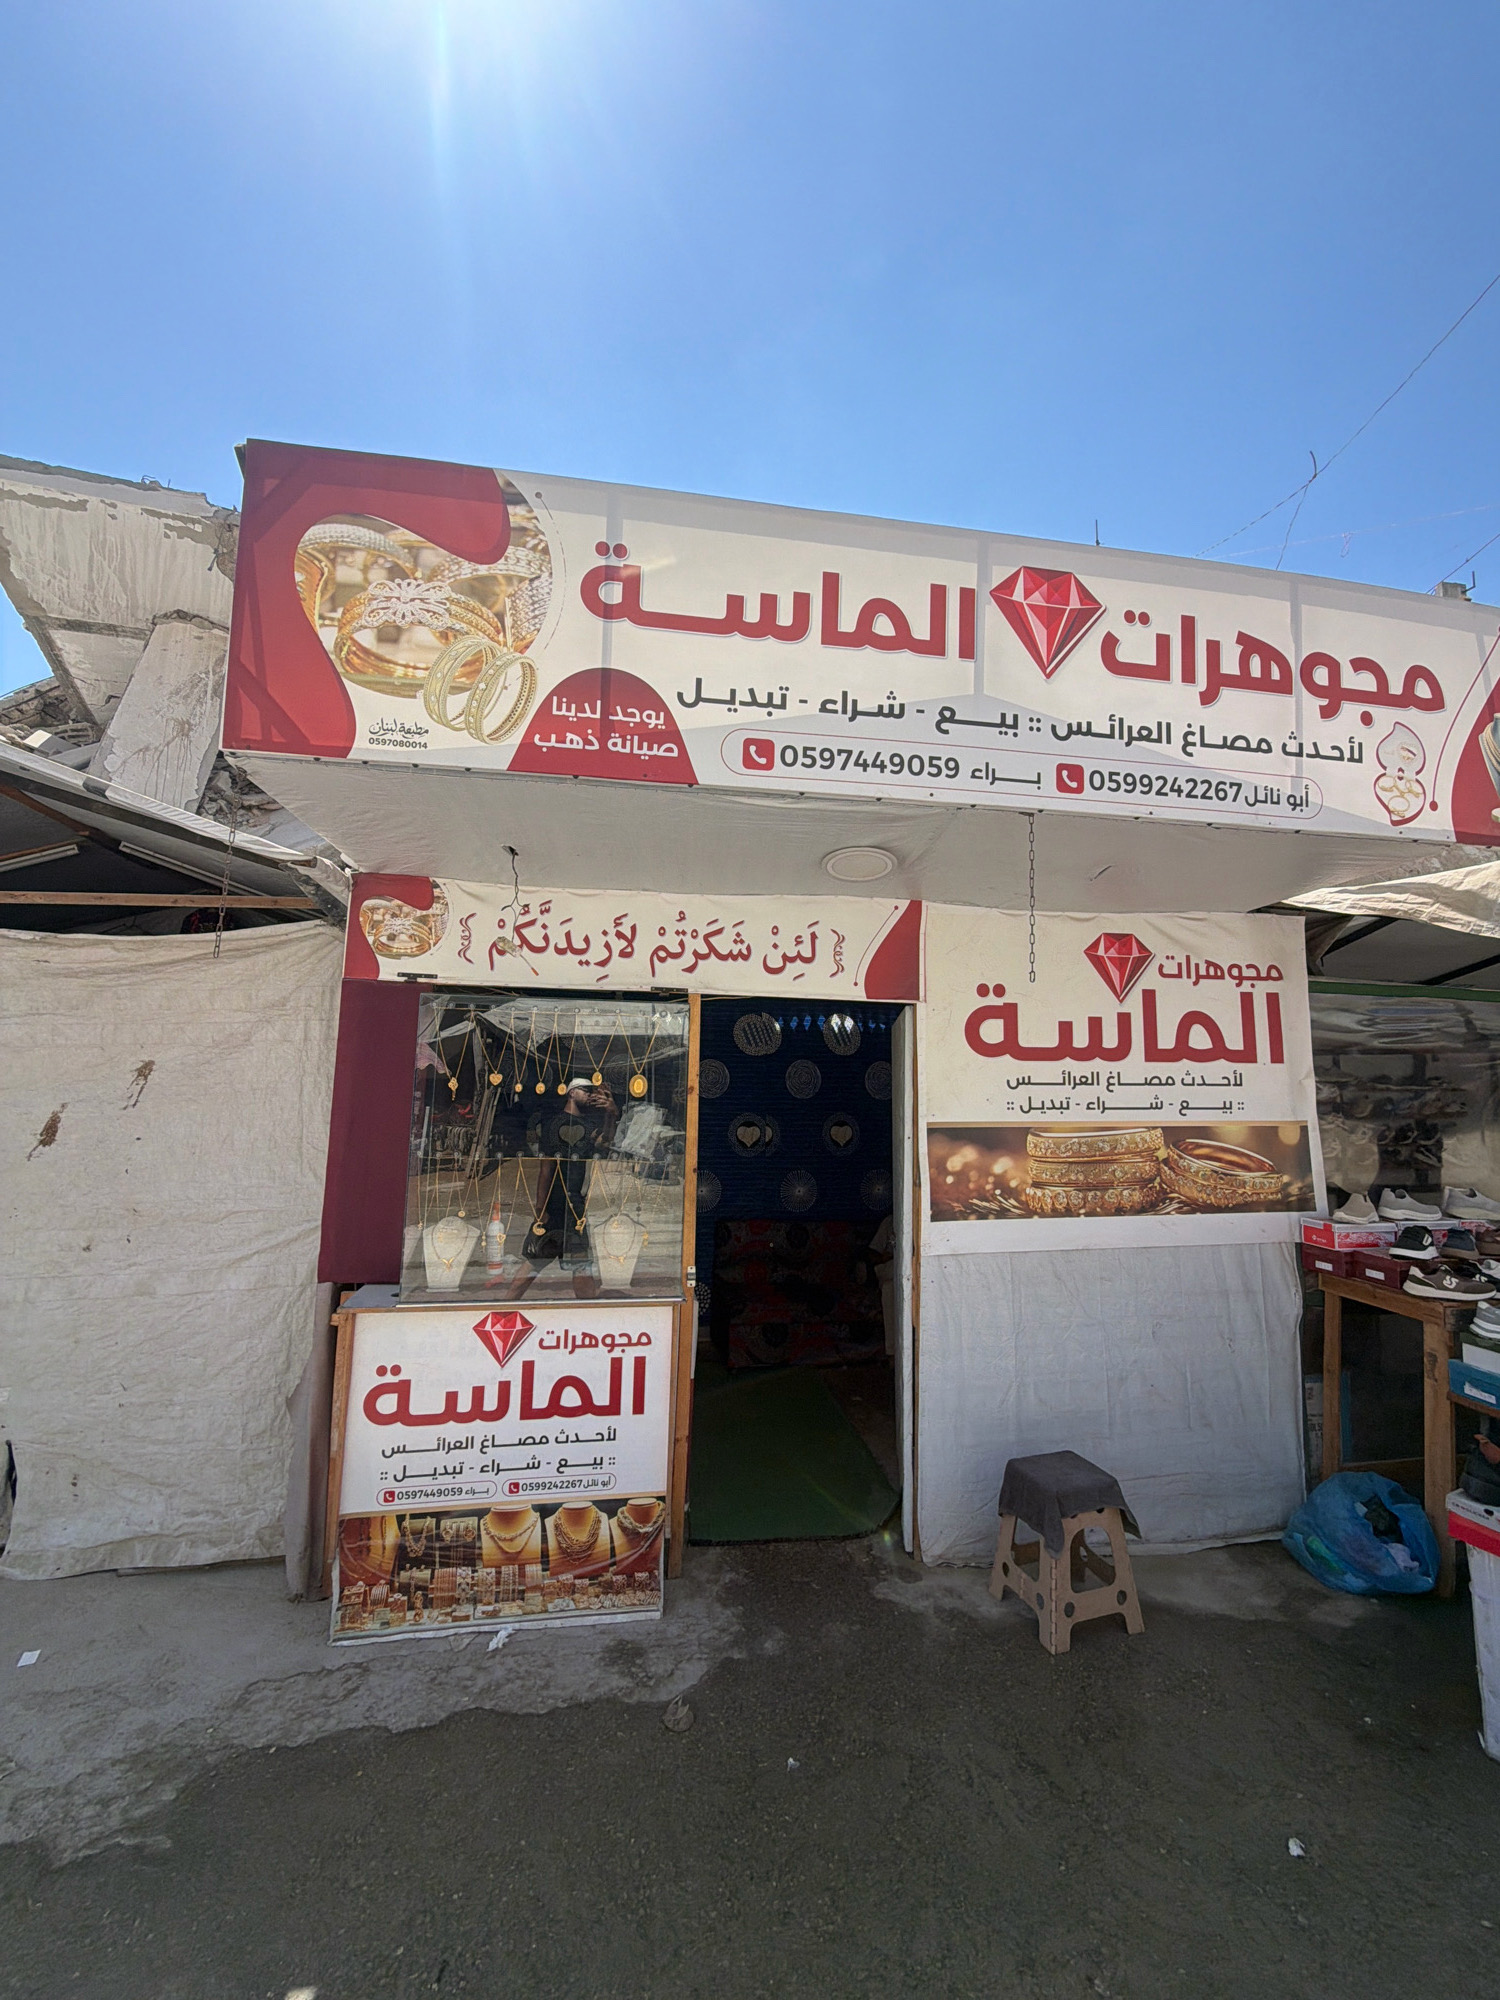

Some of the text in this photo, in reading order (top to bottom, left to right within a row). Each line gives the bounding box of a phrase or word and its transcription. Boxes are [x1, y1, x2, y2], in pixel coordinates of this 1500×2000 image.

[580, 541, 1445, 727] مجوهرات الماسة
[553, 696, 665, 729] يوجد لدينا
[677, 678, 789, 717] تبديل
[819, 691, 905, 722] شراء
[935, 706, 1018, 737] بيع
[1051, 714, 1171, 747] العرائس
[369, 738, 427, 749] 0597080014
[534, 729, 678, 759] صيانة ذهب
[1182, 723, 1272, 757] مصاغ
[1282, 731, 1363, 763] لأحدث
[779, 744, 1309, 812] أبو نائل 0599242267 براء 0597449059
[1158, 955, 1283, 988] مجوهرات
[965, 983, 1284, 1064] الماسة
[1007, 1070, 1242, 1092] لأحدث مصاغ العرائس
[1020, 1096, 1070, 1114] تبديل
[1086, 1095, 1163, 1114] شراء
[1179, 1100, 1232, 1116] بيع
[539, 1329, 651, 1354] مجوهرات
[363, 1356, 646, 1426] الماسة
[382, 1426, 616, 1458] لأحدث مصاغ العرائس
[393, 1462, 464, 1484] تبديل
[480, 1455, 540, 1476] شراء
[557, 1457, 603, 1475] بيع
[397, 1486, 490, 1500] براء 0597449059
[520, 1479, 582, 1493] 0599242267
[599, 1476, 612, 1489] أبو
